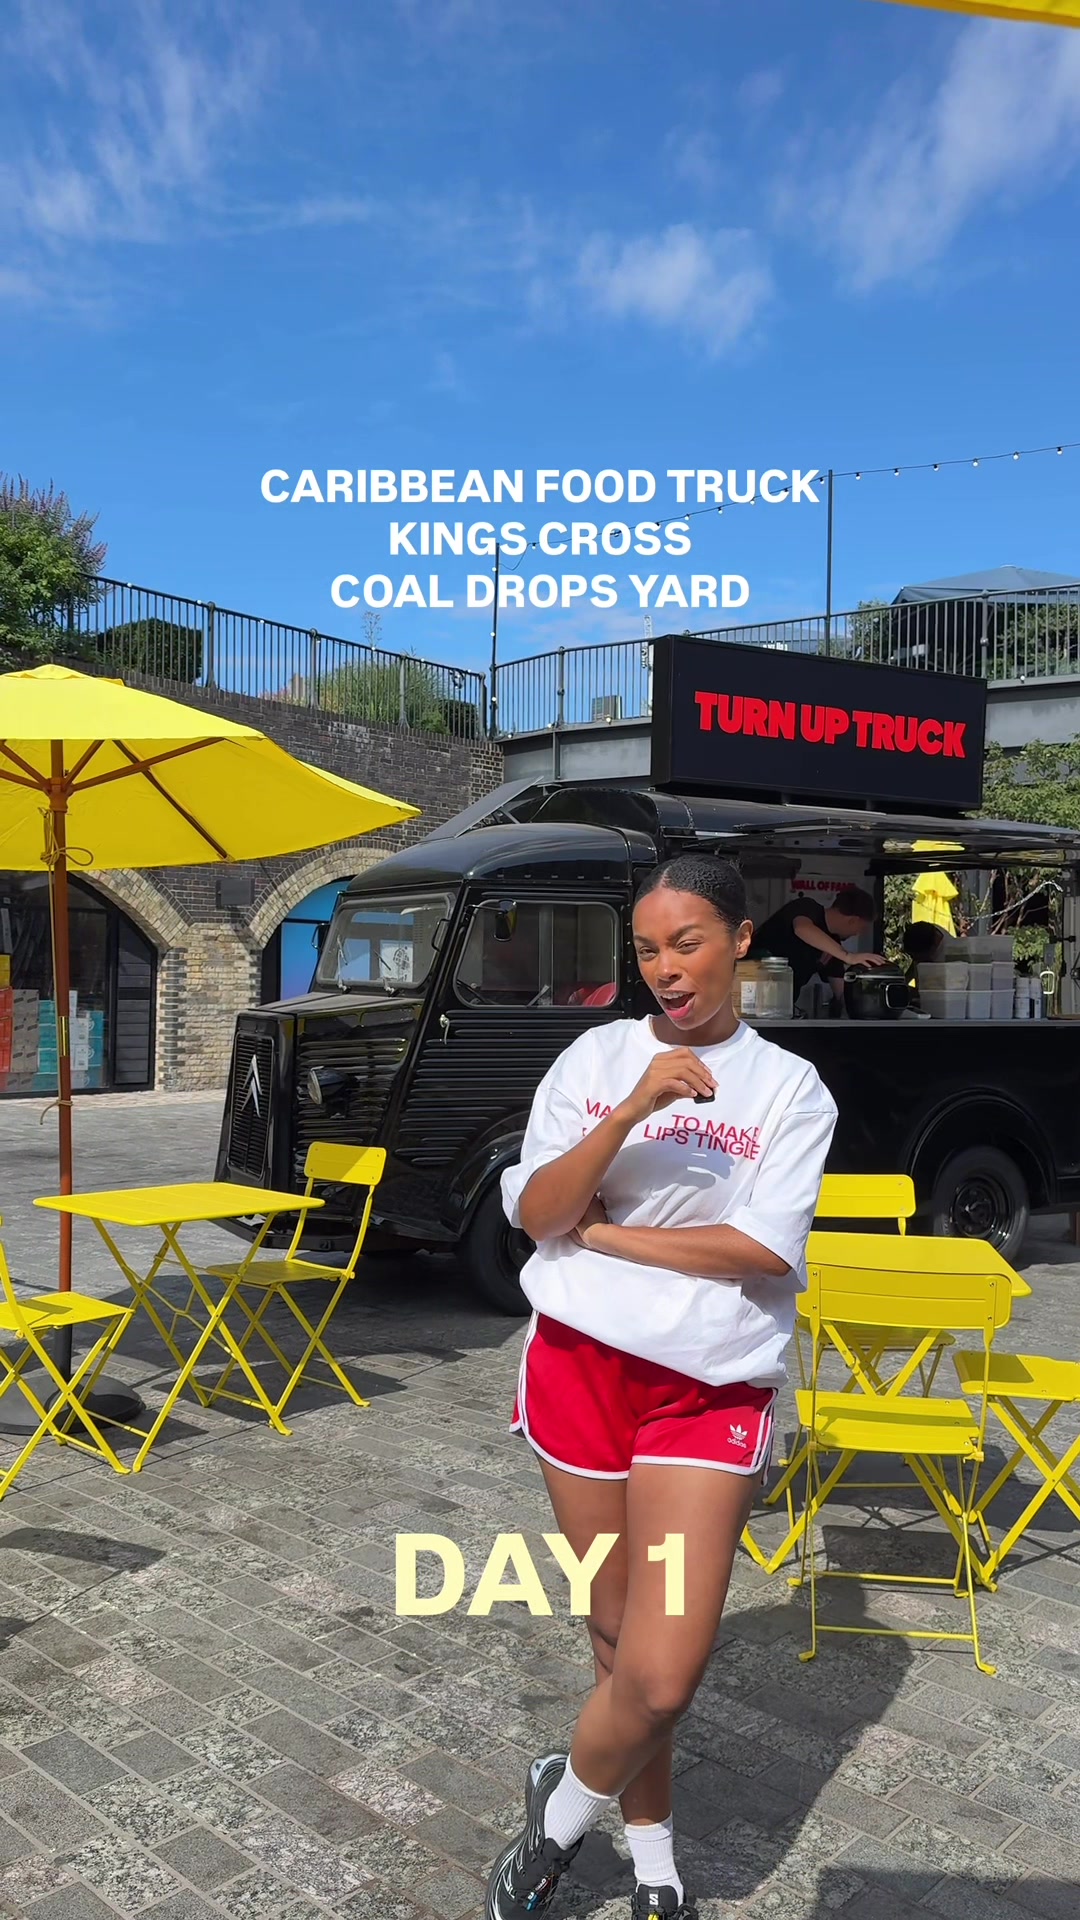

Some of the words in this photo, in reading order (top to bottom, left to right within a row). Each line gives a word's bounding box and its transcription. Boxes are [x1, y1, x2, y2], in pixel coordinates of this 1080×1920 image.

[694, 691, 796, 740] TURN
[800, 704, 850, 744] UP
[852, 710, 967, 759] TRUCK
[791, 879, 816, 891] WALL
[817, 880, 830, 891] OF
[671, 1114, 700, 1132] TO
[643, 1124, 690, 1145] LIPS
[694, 1132, 760, 1160] TINGLE
[726, 1437, 747, 1449] adidas
